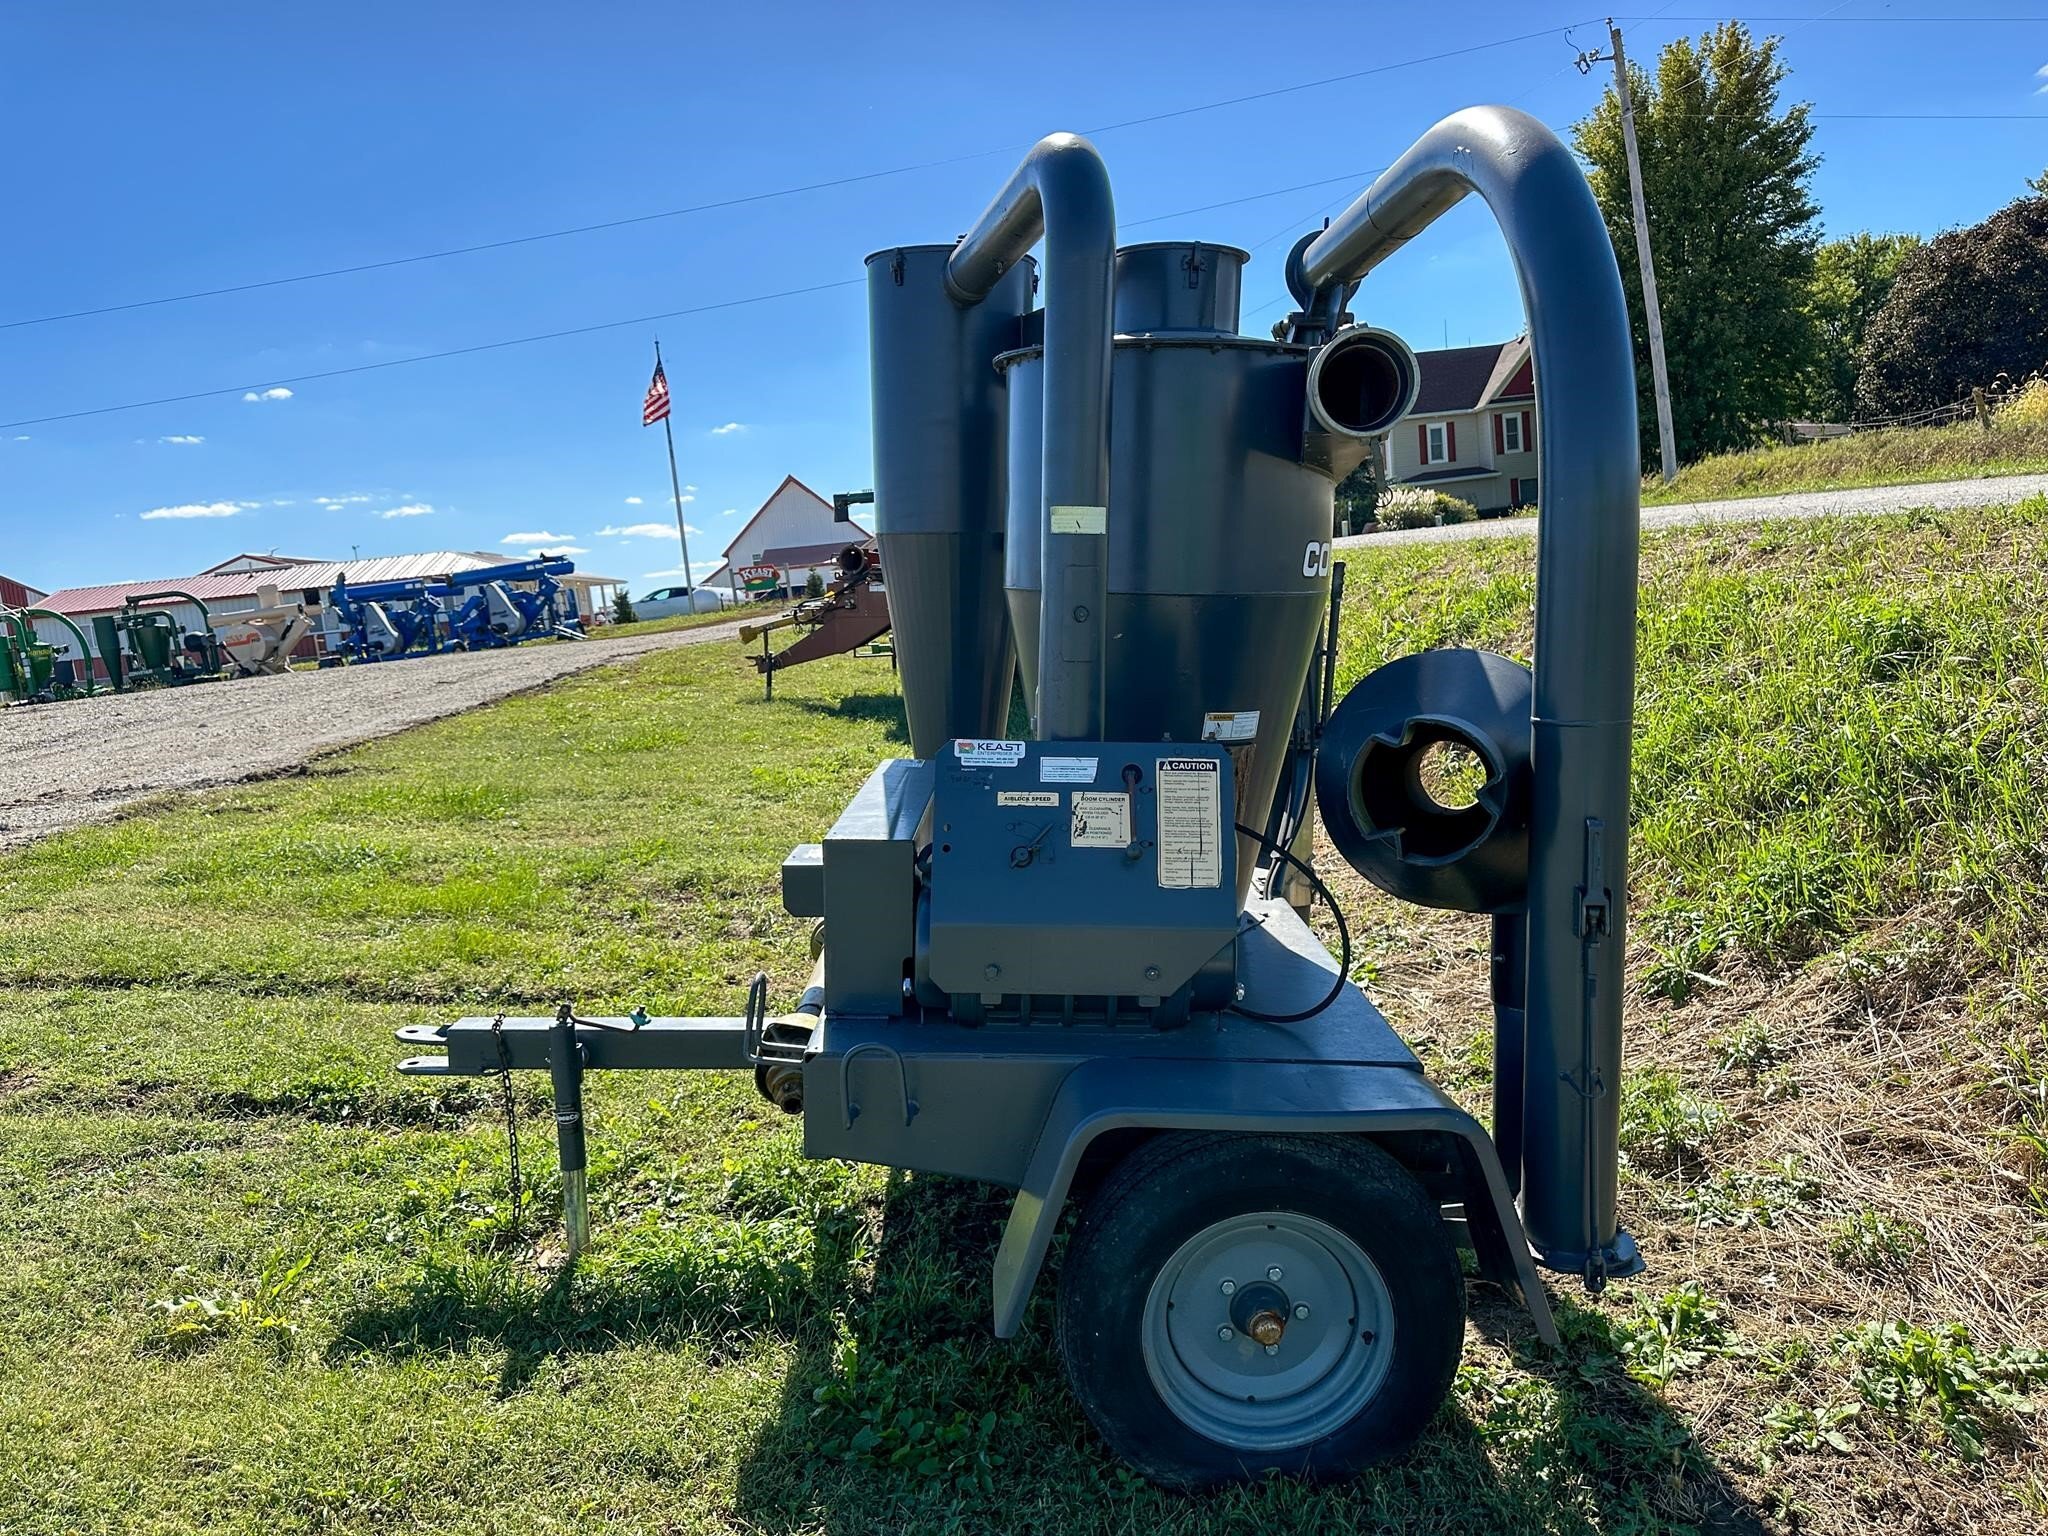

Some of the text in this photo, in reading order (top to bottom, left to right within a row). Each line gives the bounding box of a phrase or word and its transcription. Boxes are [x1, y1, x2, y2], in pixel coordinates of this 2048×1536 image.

[741, 567, 773, 581] KEAST
[978, 743, 1022, 751] KEAST
[1172, 762, 1213, 770] CAUTION
